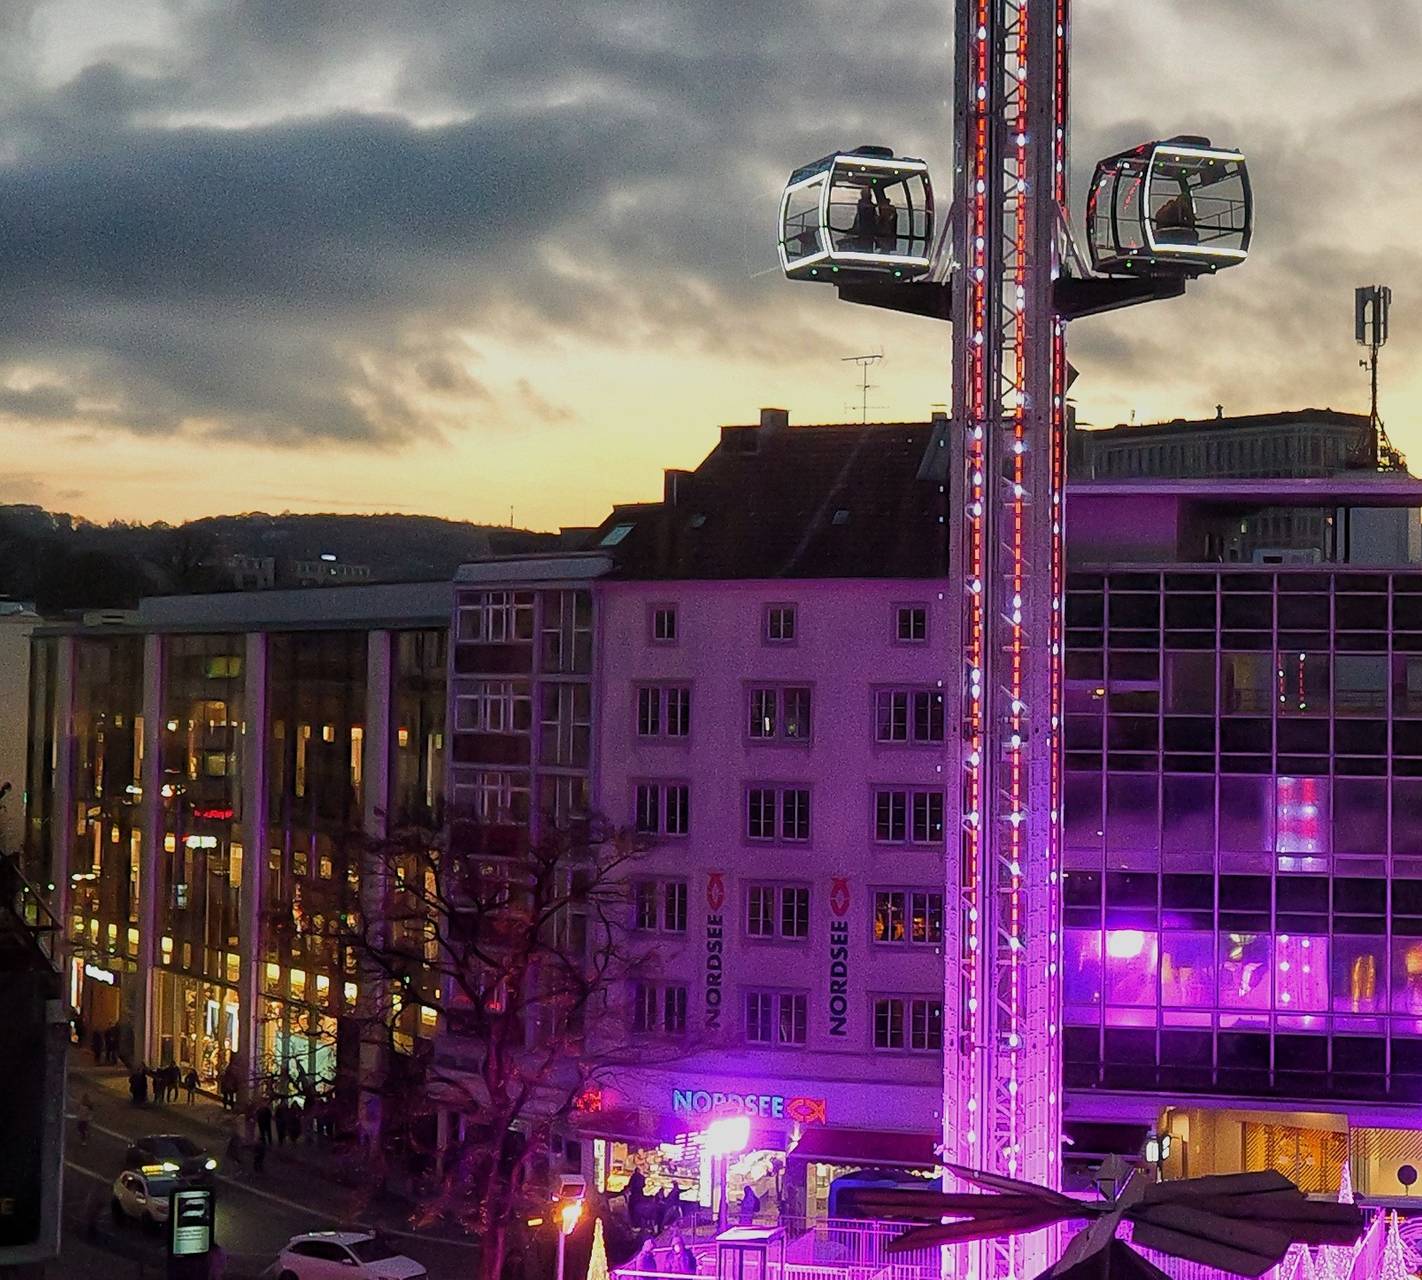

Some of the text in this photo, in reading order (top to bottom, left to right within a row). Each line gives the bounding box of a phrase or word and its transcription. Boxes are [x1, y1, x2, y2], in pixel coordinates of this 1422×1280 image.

[705, 914, 723, 1032] NORDSEE
[829, 920, 849, 1036] NORDSEE
[672, 1089, 785, 1119] NORDSEE
